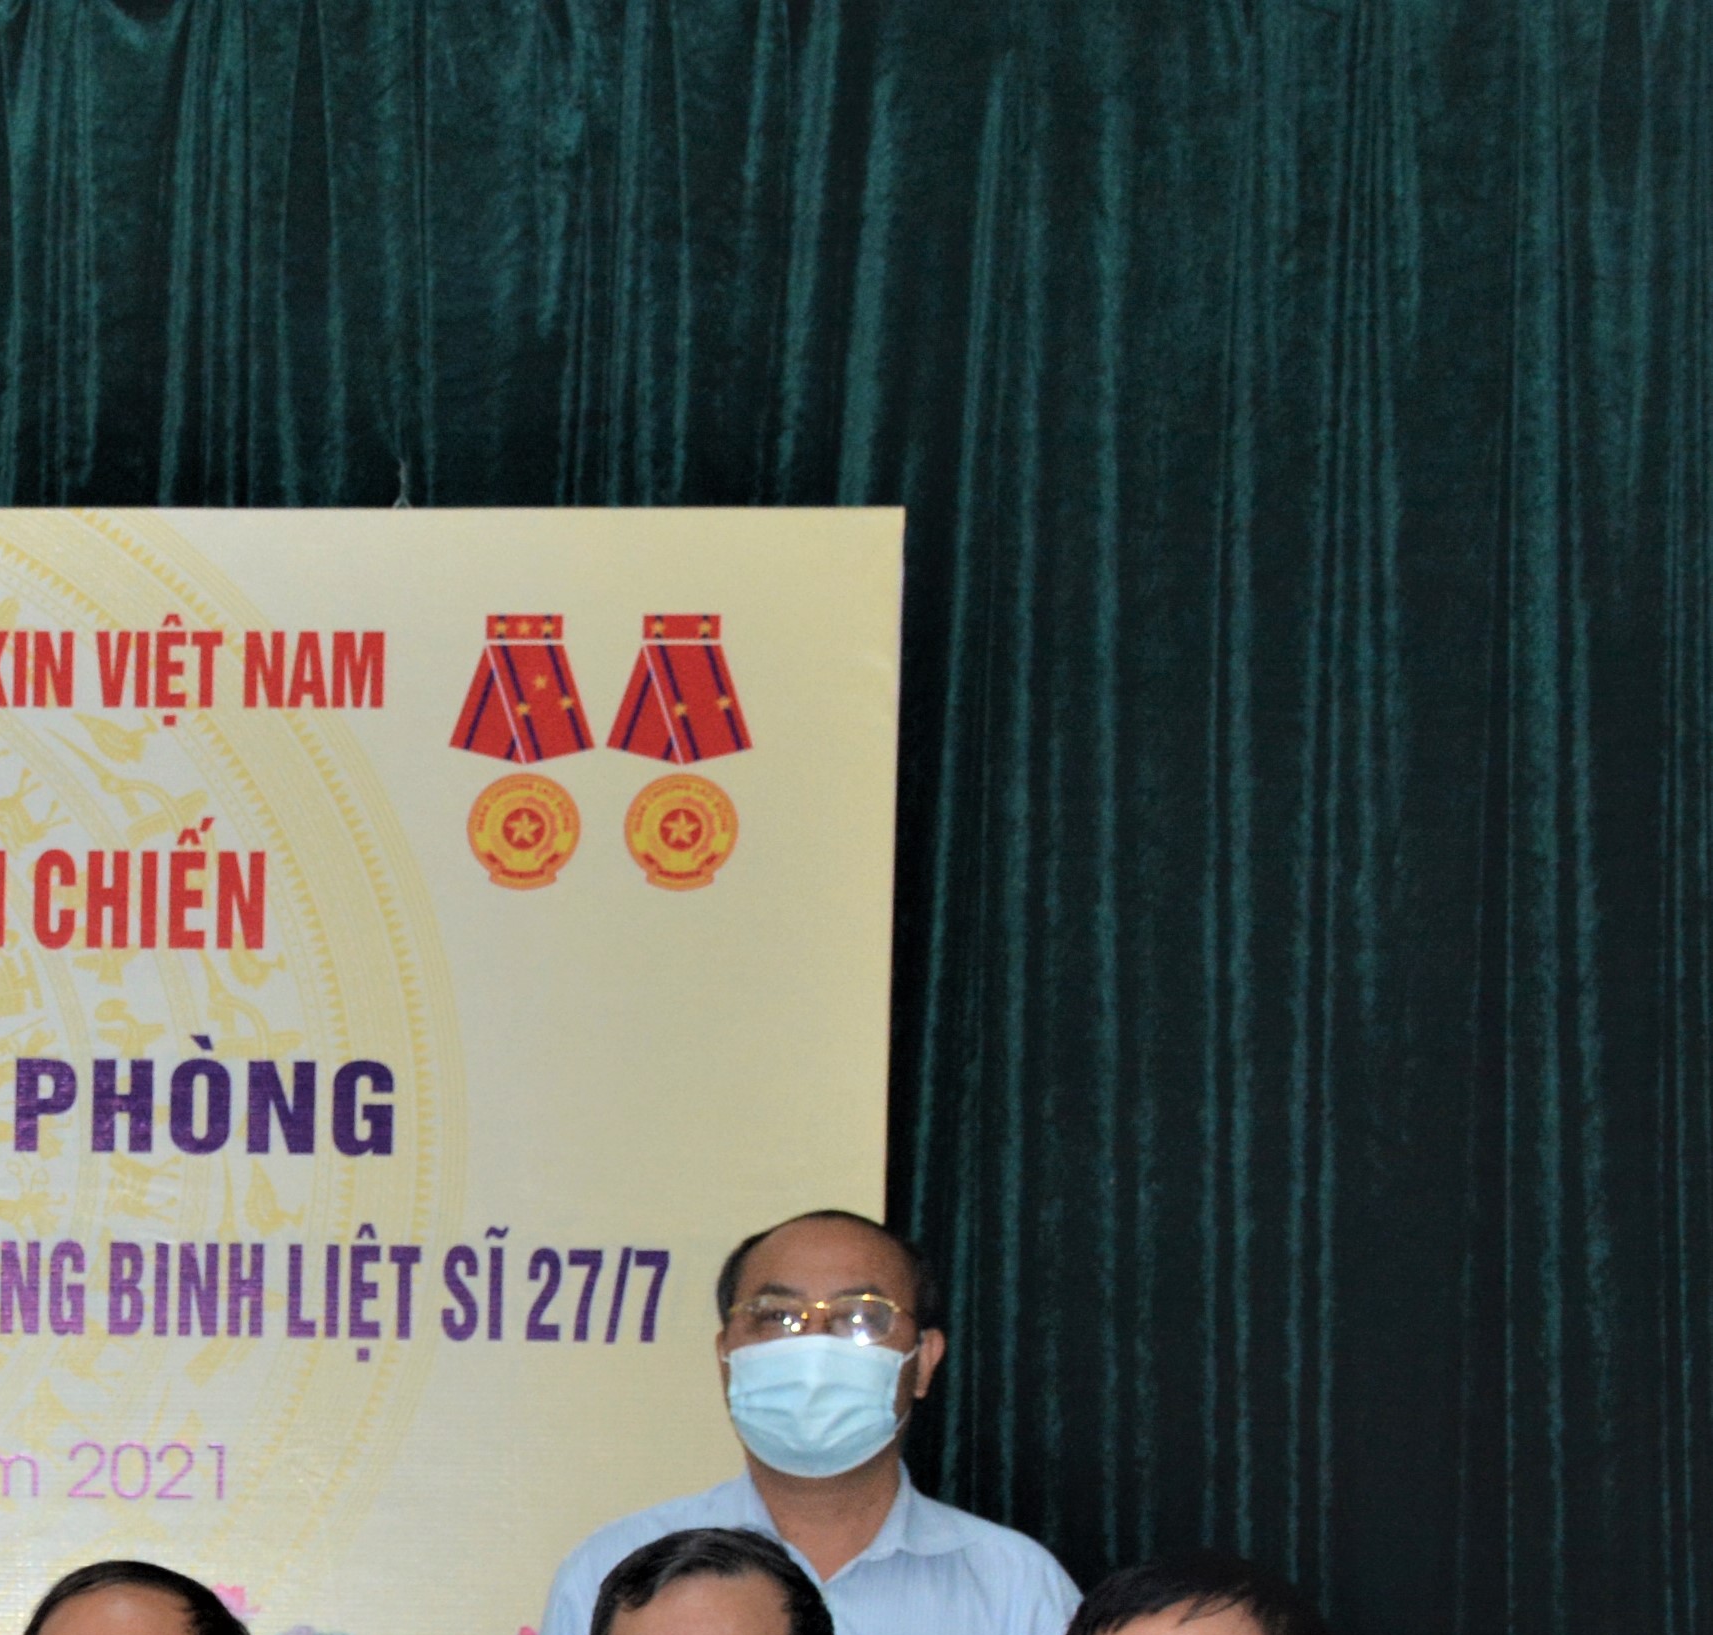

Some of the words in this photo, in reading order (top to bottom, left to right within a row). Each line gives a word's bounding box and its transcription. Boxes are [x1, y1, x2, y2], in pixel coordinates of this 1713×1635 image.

[97, 614, 224, 726] VIỆT
[244, 631, 385, 708] NAM
[34, 817, 266, 950] CHIẾN
[13, 1035, 395, 1157] PHÒNG
[108, 1241, 266, 1338] BINH
[286, 1223, 422, 1361] LIỆT
[441, 1226, 509, 1342] SĨ
[526, 1246, 671, 1344] 27/7
[67, 1441, 228, 1501] 2021
